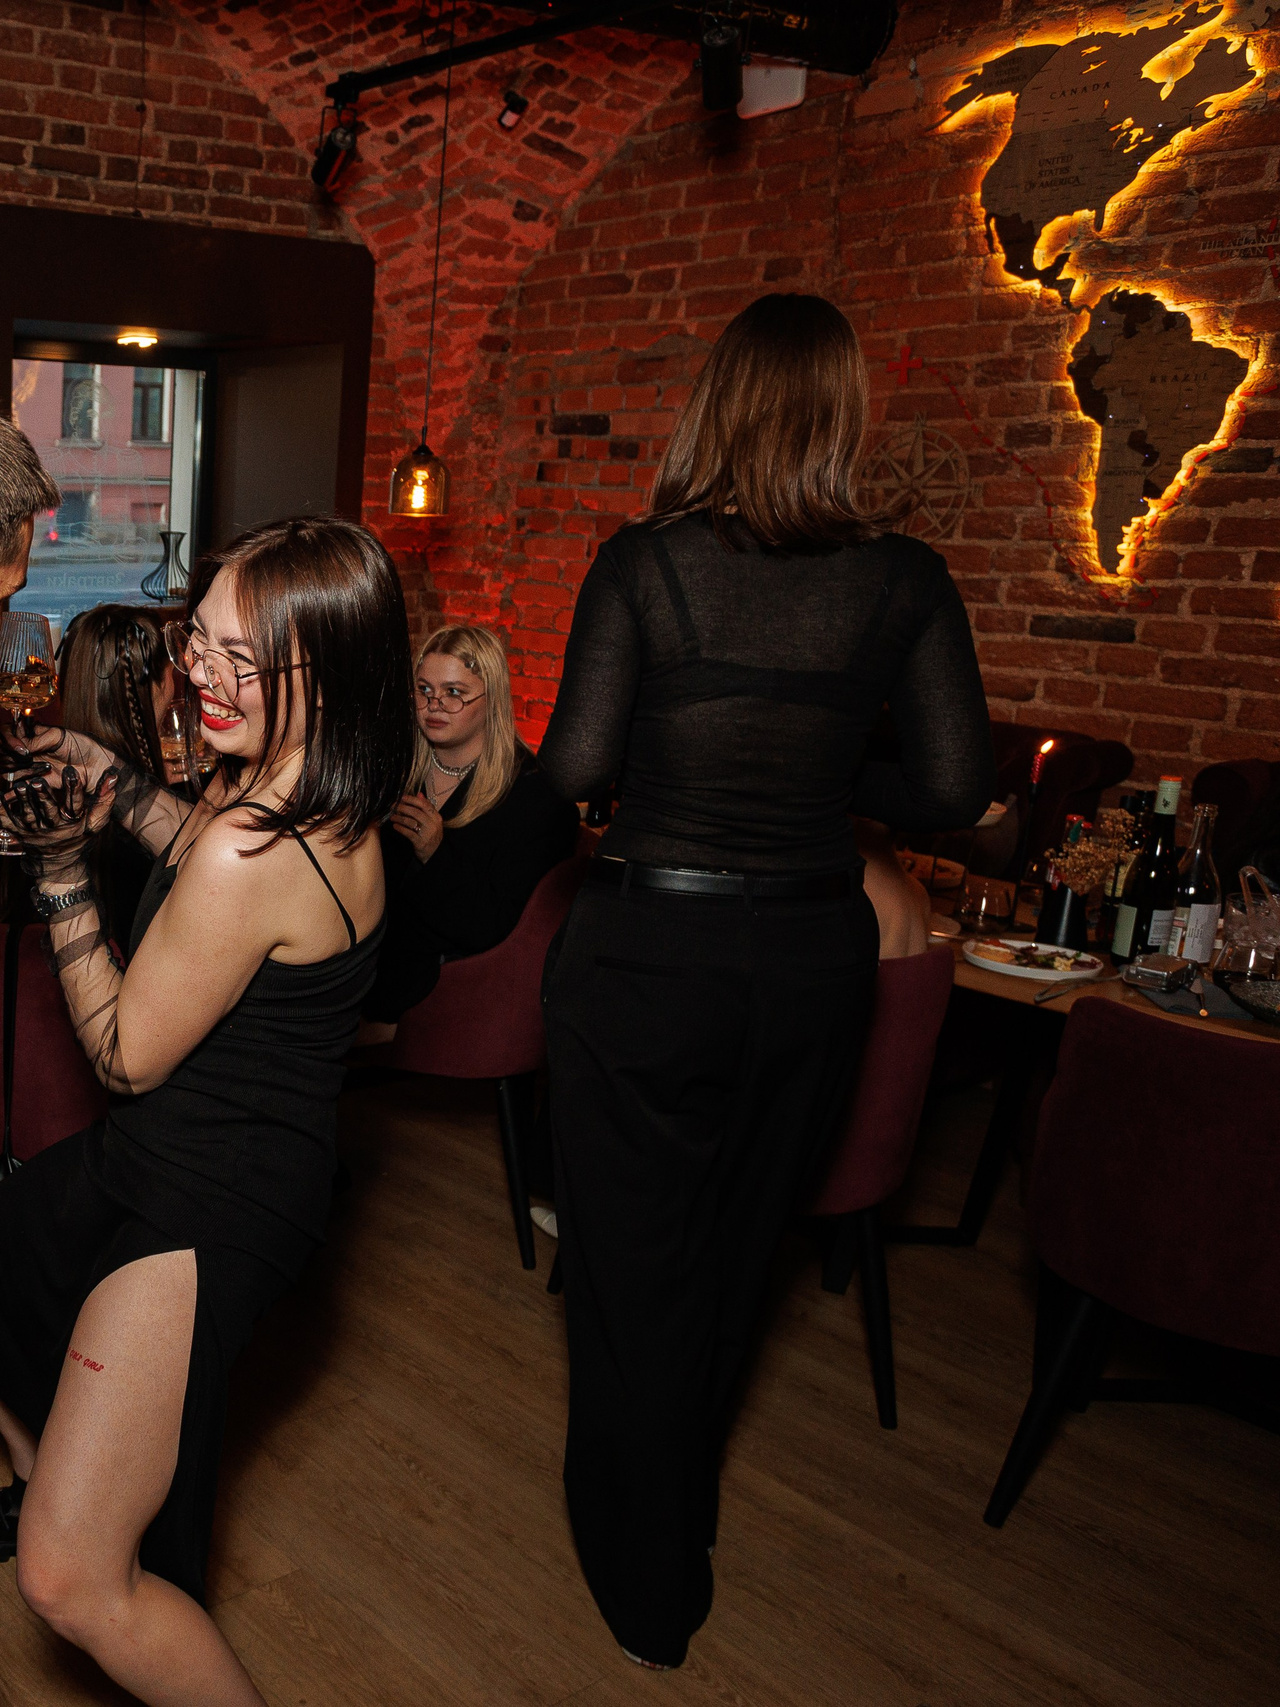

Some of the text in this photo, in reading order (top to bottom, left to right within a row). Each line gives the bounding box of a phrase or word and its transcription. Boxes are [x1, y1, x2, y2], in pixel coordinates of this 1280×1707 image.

[996, 74, 1027, 86] AMERICA
[1049, 81, 1111, 100] CANADA
[1038, 154, 1074, 167] UNITED
[1038, 166, 1070, 178] STATES
[1039, 175, 1080, 188] AMERICA
[1199, 239, 1225, 252] THE
[1149, 372, 1209, 384] BRAZIL
[83, 1358, 104, 1372] GIRLS
